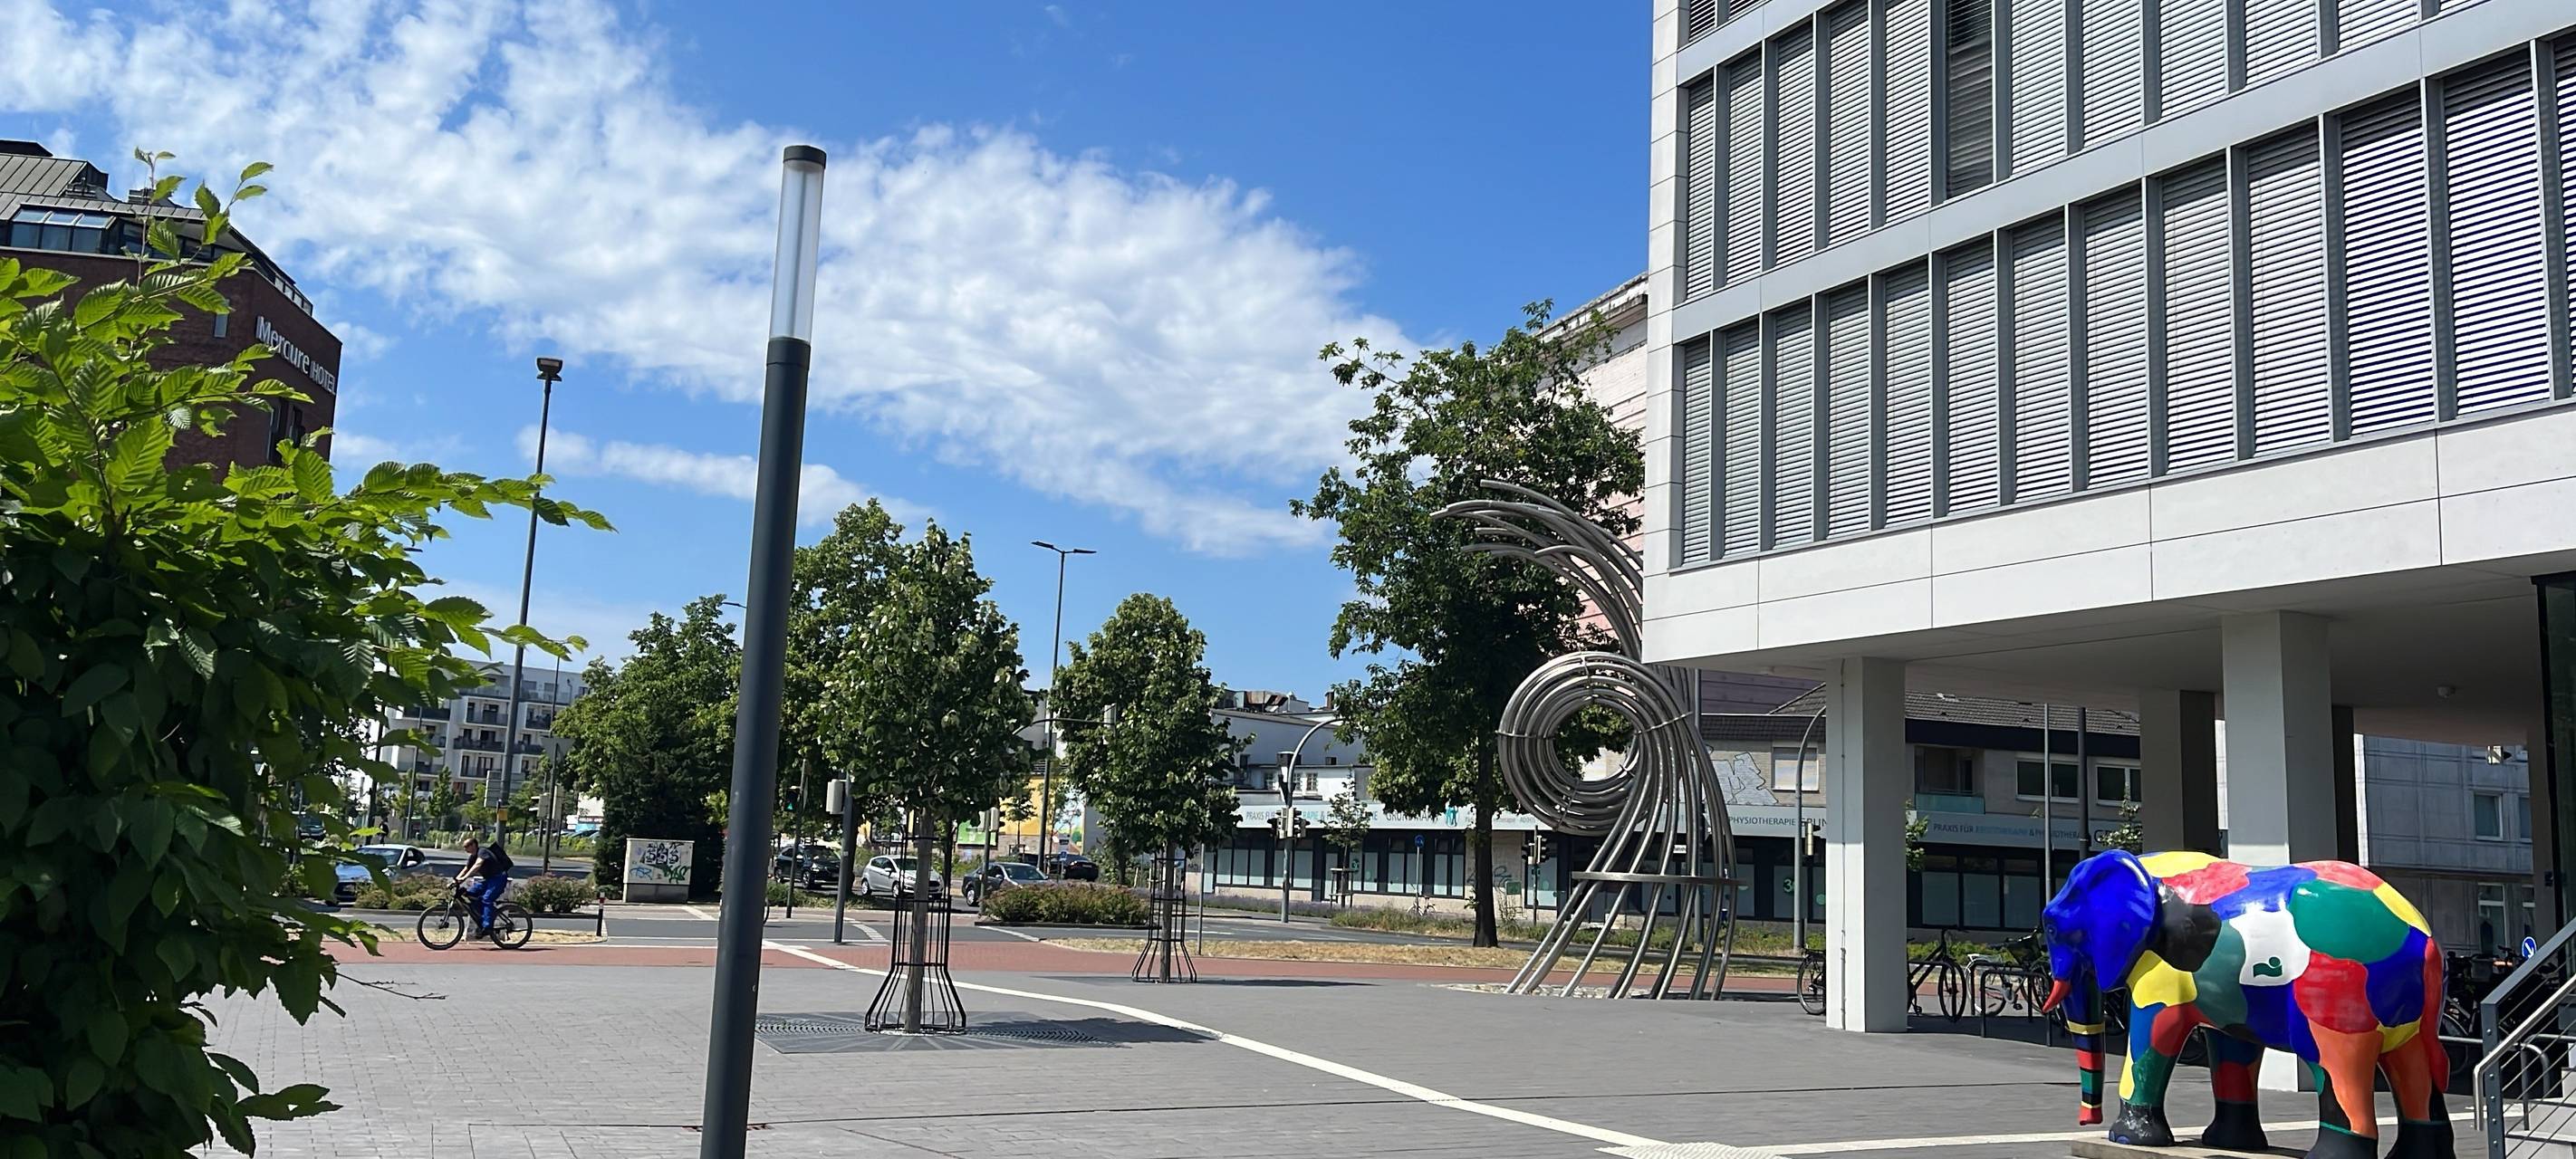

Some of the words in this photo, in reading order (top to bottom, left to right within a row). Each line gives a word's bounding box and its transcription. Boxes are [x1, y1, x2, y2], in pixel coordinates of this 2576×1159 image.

[255, 315, 310, 374] Mercure
[310, 360, 336, 396] HOTEL
[1728, 816, 1797, 826] PHYSIOTHERAPIE
[1933, 823, 1958, 833] PRAXIS
